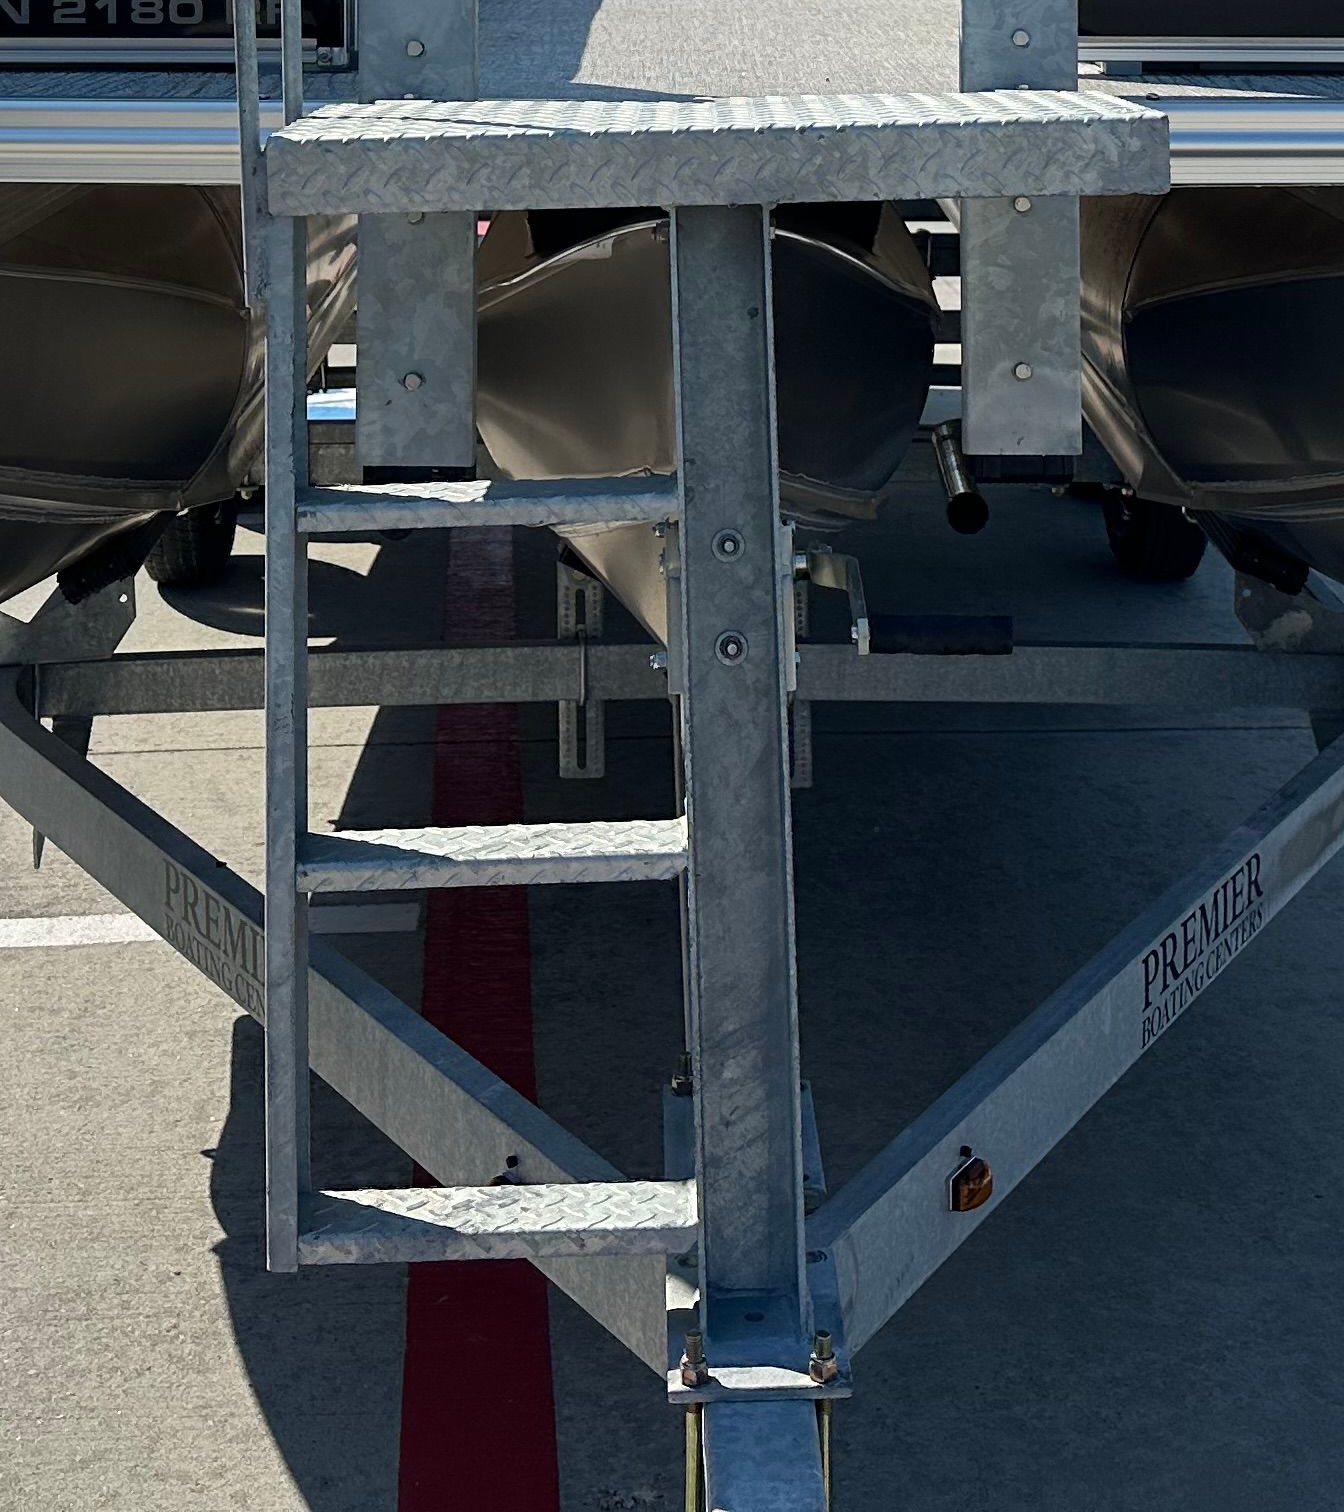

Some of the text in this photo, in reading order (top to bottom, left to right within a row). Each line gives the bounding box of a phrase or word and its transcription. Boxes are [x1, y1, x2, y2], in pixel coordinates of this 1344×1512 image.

[163, 858, 265, 987] PREMI
[164, 913, 233, 992] BOATING
[1139, 903, 1264, 1050] BOATING CENTERS
[1141, 852, 1264, 1014] PREMIER
